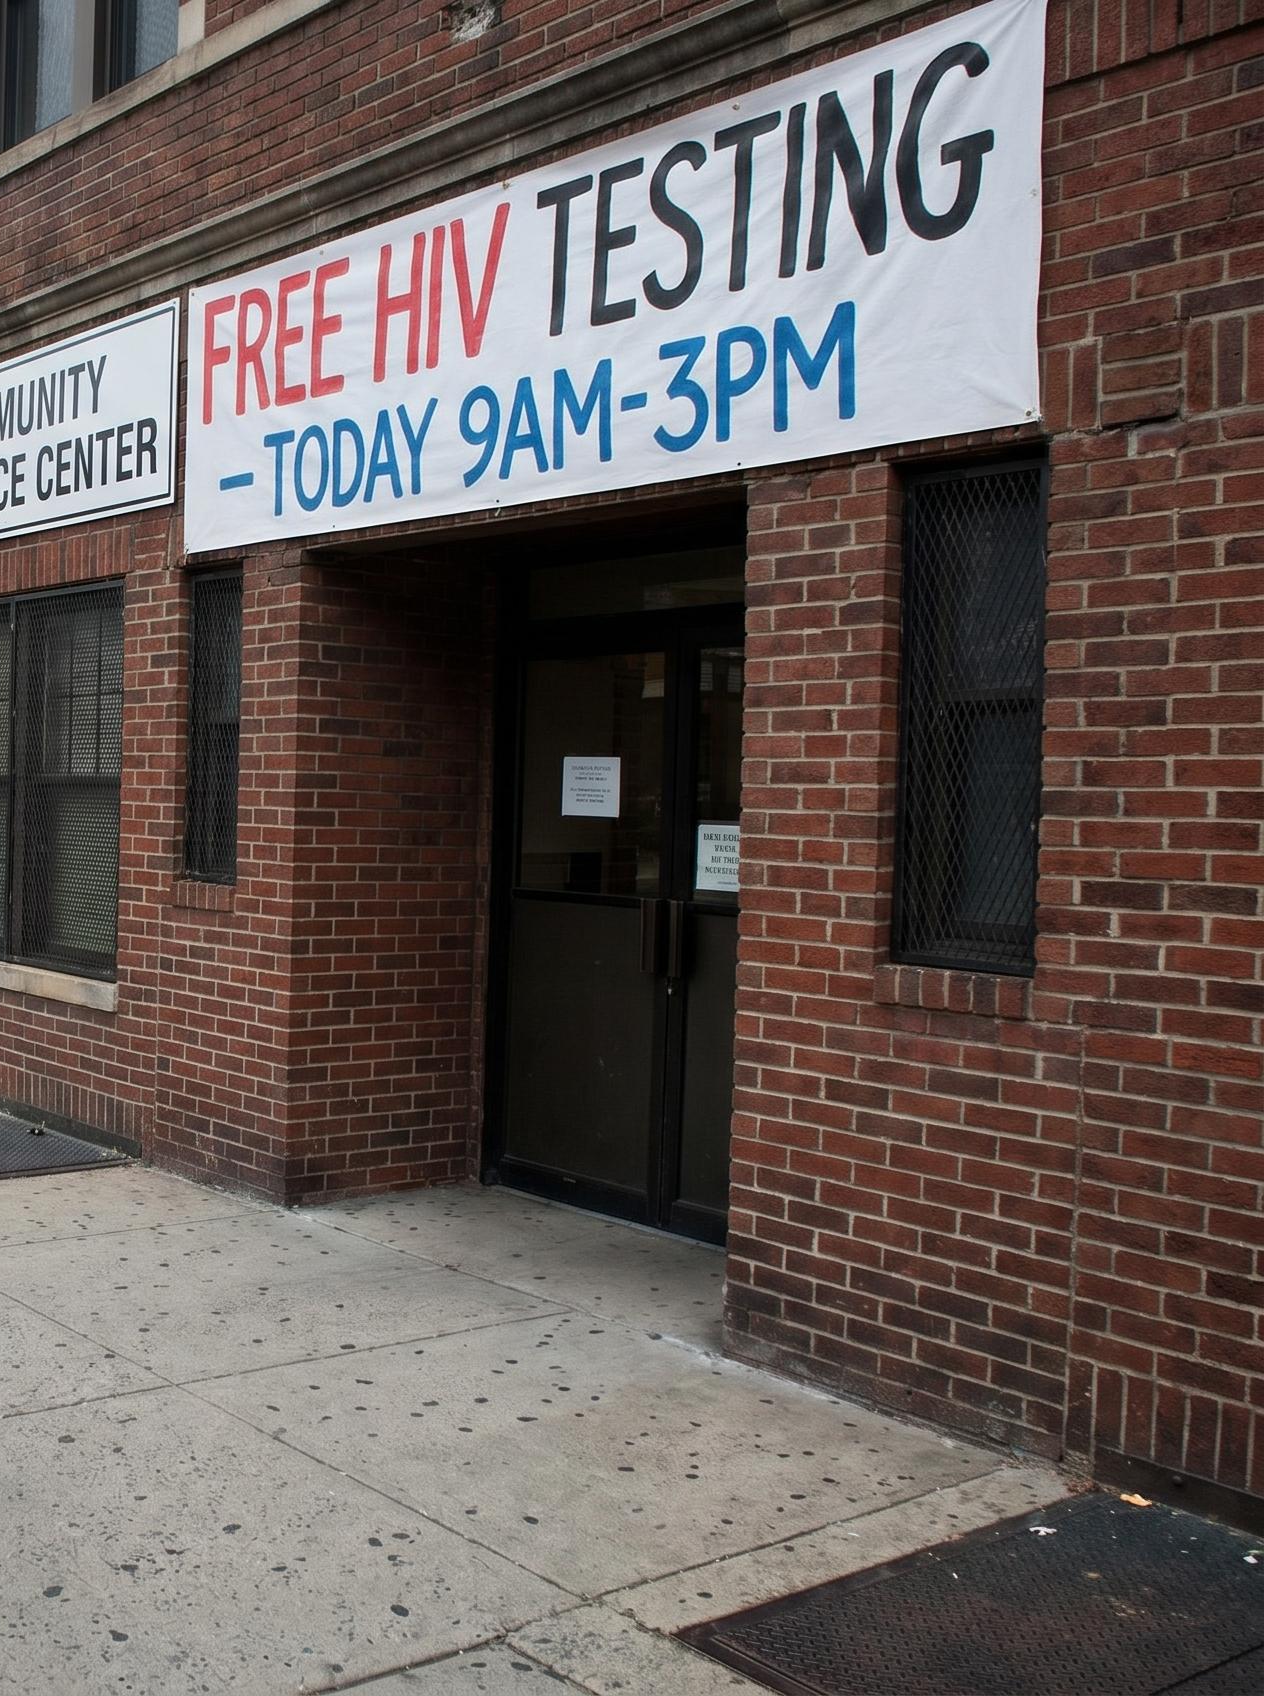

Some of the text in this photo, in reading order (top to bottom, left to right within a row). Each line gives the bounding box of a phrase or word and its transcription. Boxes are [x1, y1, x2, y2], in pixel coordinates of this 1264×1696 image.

[202, 41, 995, 426] FREE HIV TESTING
[36, 417, 158, 501] CENTER
[458, 301, 856, 489] 9AM-3PM
